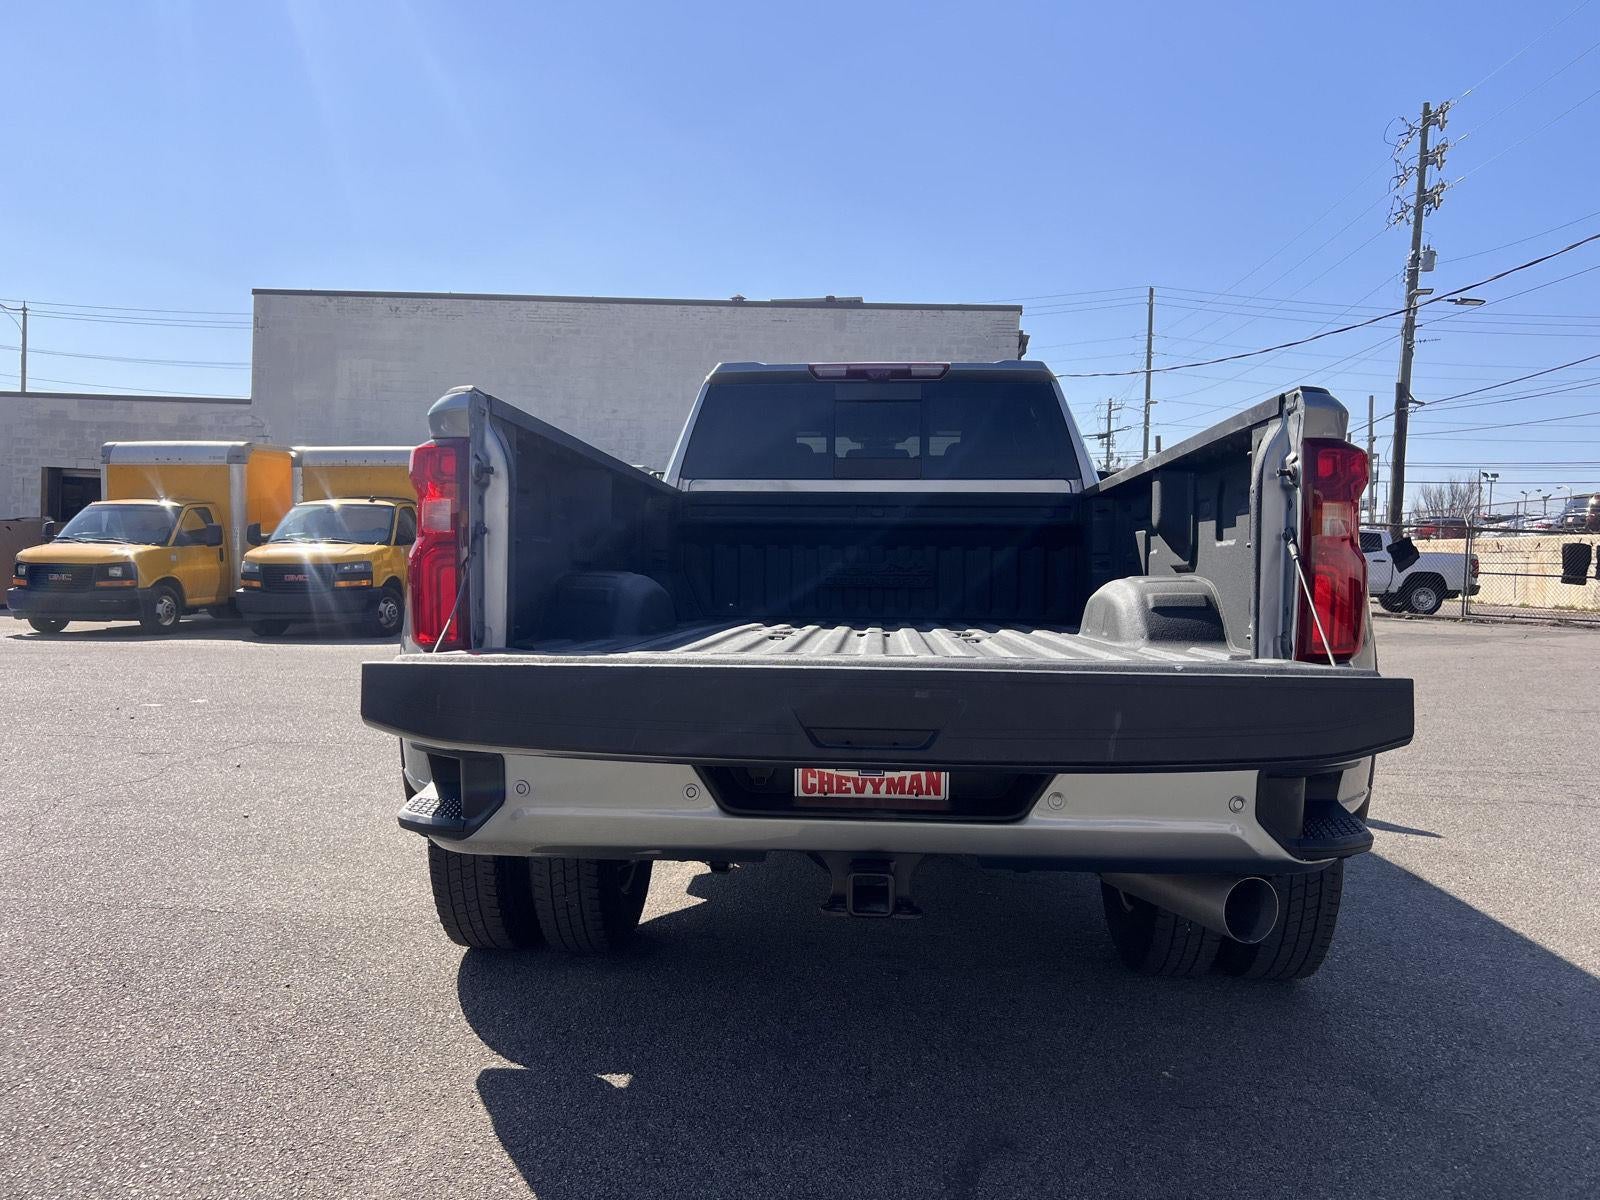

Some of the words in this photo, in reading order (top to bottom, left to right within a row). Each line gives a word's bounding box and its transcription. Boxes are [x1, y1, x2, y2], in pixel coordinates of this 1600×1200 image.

[48, 573, 72, 581] GMC
[284, 574, 309, 582] GMC
[801, 768, 942, 796] CHEVYMAN
